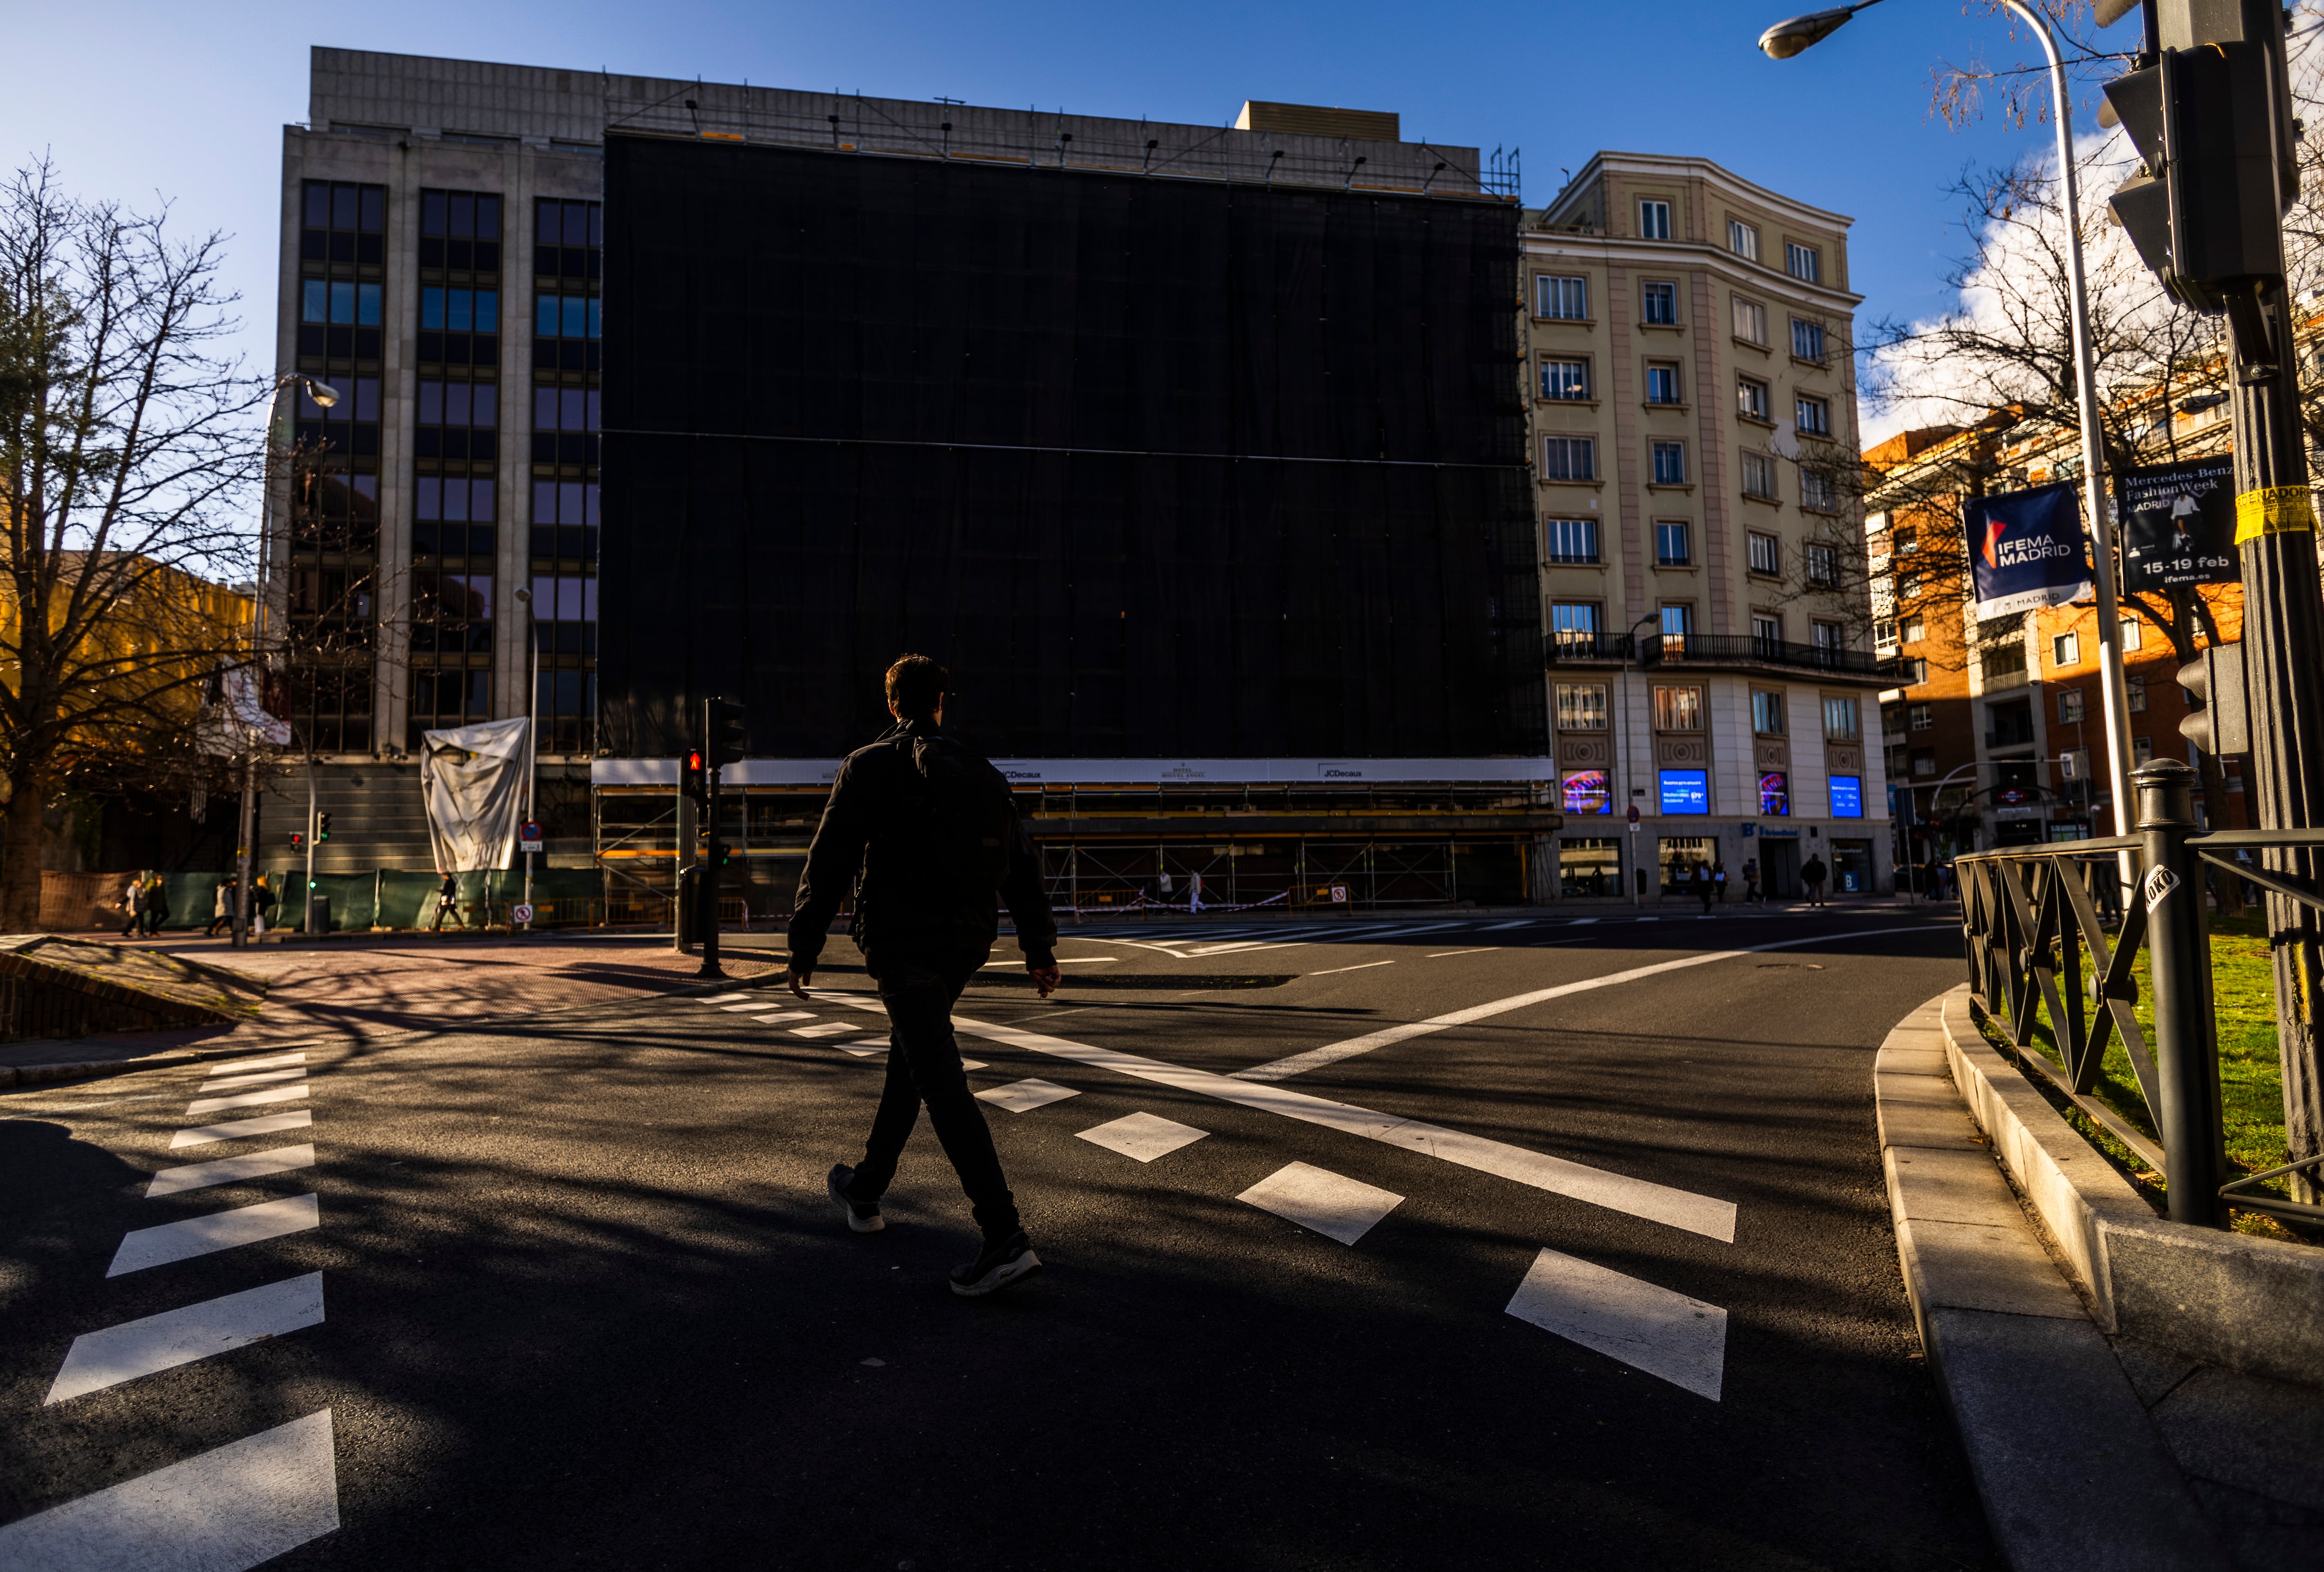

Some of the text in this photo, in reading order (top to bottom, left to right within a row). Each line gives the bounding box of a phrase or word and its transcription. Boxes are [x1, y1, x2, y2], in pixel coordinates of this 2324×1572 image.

[2125, 467, 2233, 489] Mercedes-Benz
[2127, 499, 2170, 513] MADRID
[2238, 487, 2311, 508] RDENADORE
[1998, 534, 2054, 555] IFEMA
[2000, 544, 2071, 567] MADRID
[2142, 555, 2230, 575] 15-19 feb
[2164, 574, 2211, 584] ifema.es
[2017, 593, 2060, 606] MADRID
